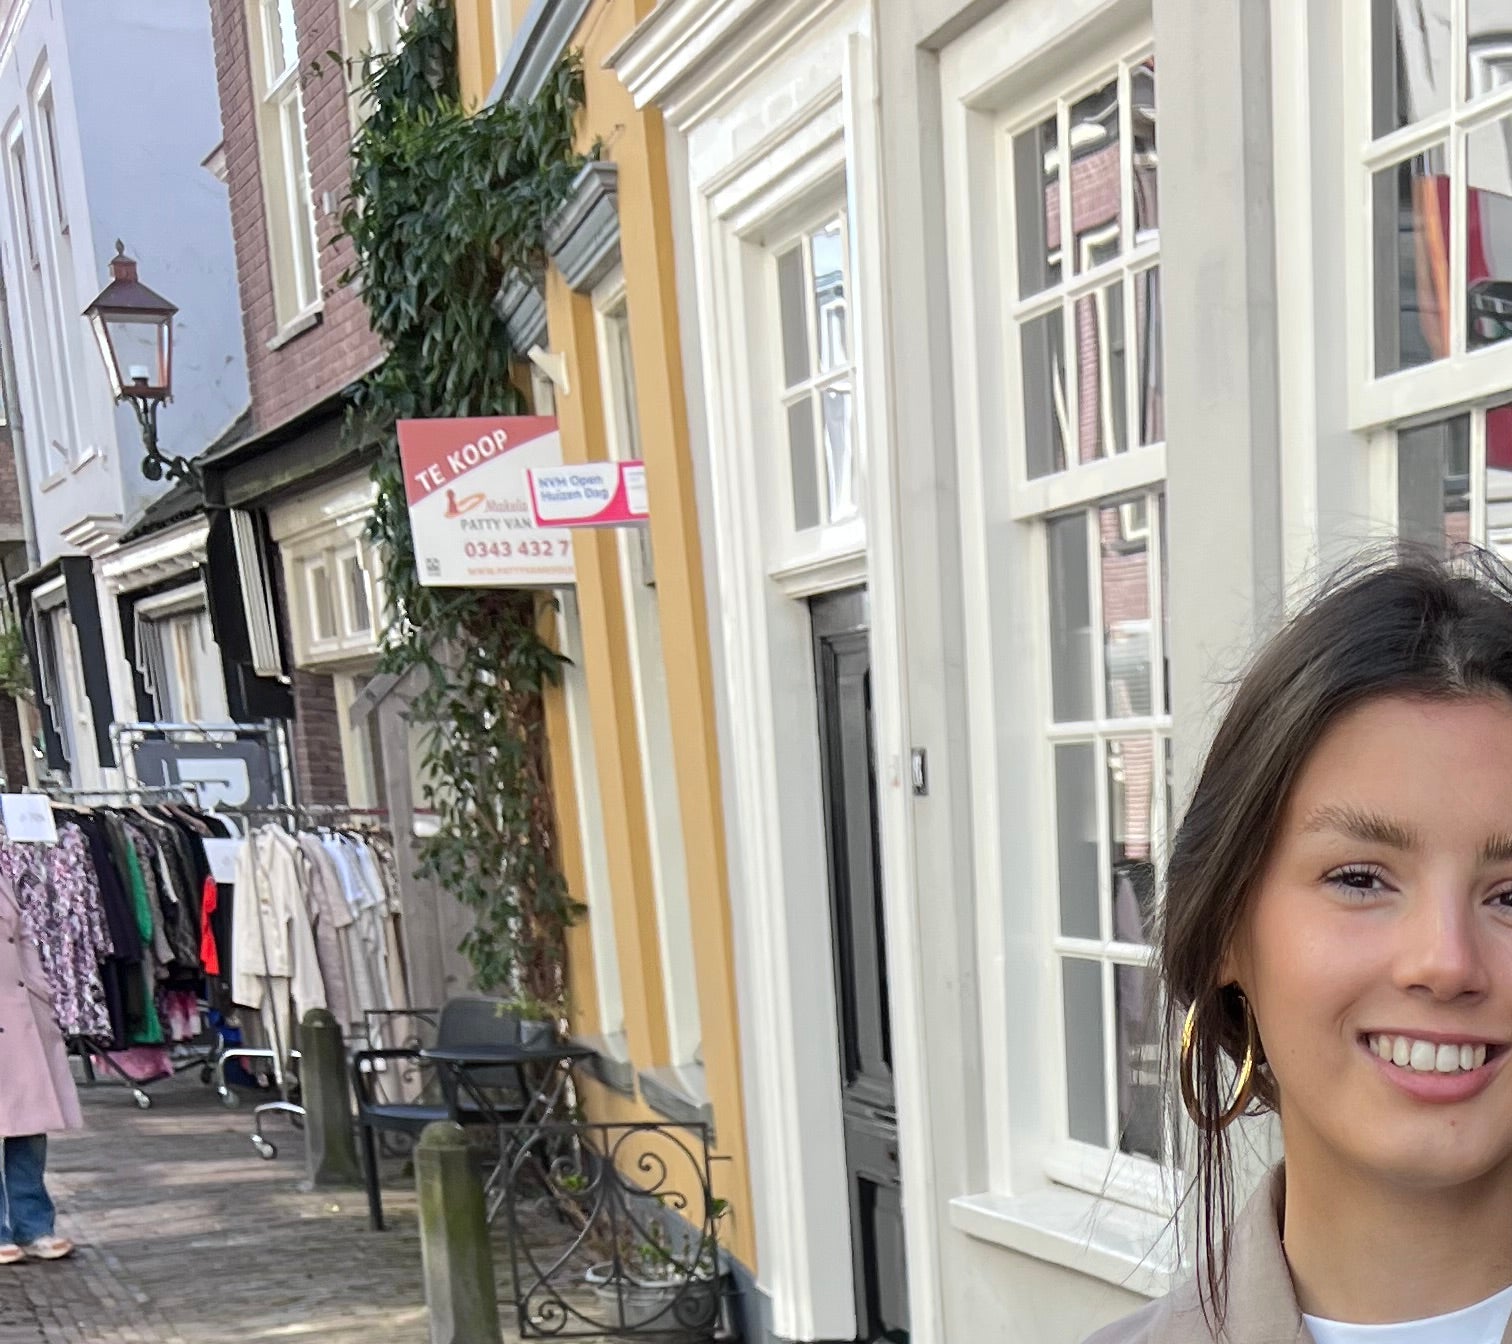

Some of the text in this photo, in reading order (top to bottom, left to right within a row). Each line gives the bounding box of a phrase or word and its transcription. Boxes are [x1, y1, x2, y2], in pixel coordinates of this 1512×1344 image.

[414, 428, 508, 493] TE KOOP
[569, 475, 602, 487] Open
[460, 516, 532, 530] PATTY VAN
[464, 541, 512, 558] 0343
[517, 540, 553, 557] 432
